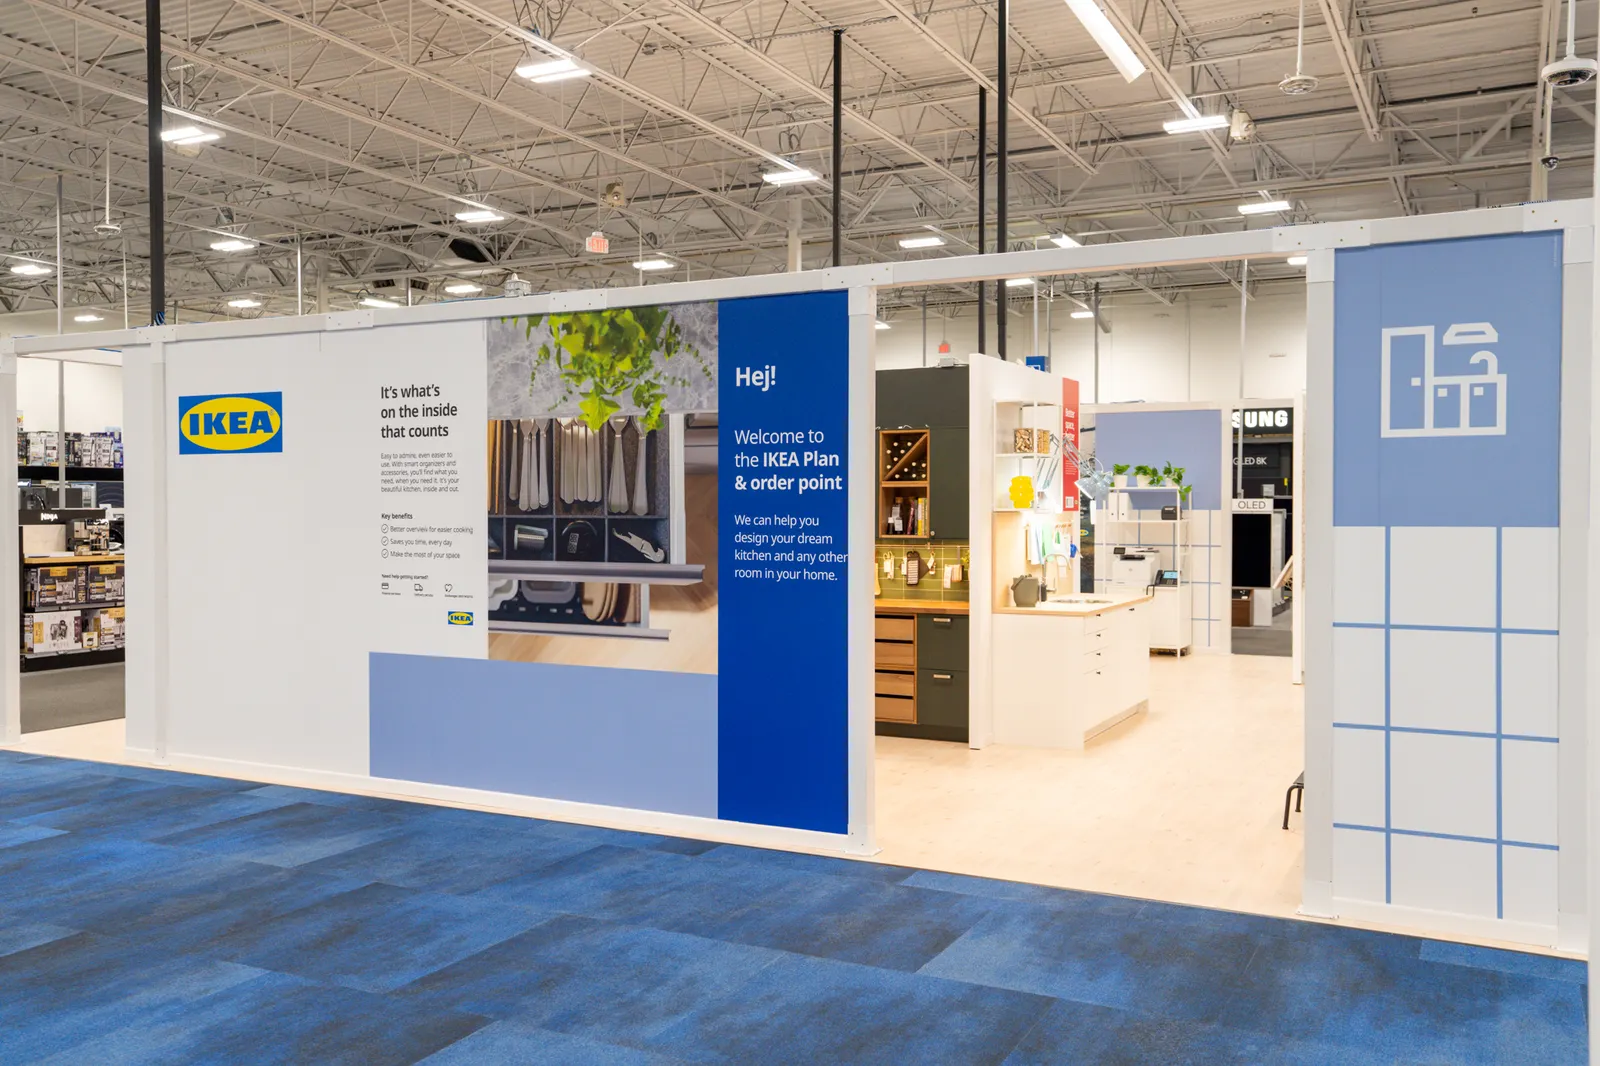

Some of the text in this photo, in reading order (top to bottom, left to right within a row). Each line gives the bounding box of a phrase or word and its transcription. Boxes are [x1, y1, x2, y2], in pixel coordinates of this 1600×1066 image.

[736, 365, 776, 391] Hej!
[381, 403, 457, 418] on the inside
[189, 410, 274, 436] IKEA
[381, 425, 448, 438] that counts
[734, 429, 824, 444] Welcome to
[419, 460, 445, 468] organizers
[734, 451, 839, 467] the IKEA Plan
[1256, 457, 1268, 465] 8K
[735, 474, 842, 494] & order point
[1238, 501, 1266, 509] OLED
[41, 513, 58, 521] NINJA
[734, 514, 819, 529] We can help you
[734, 532, 832, 546] design your dream
[433, 552, 445, 560] your
[734, 549, 848, 565] kitchen and any other
[734, 568, 838, 582] room in your home.
